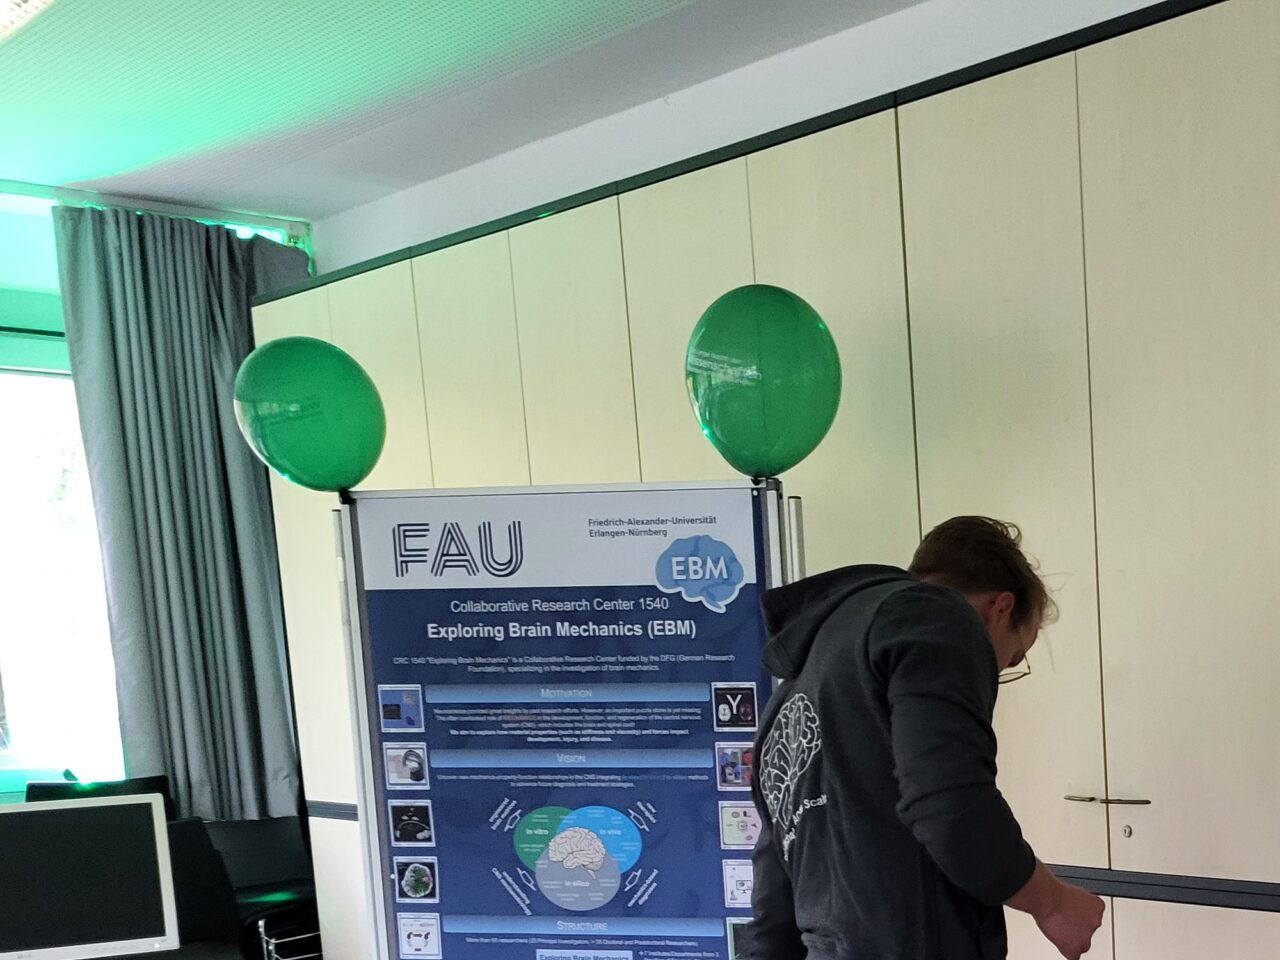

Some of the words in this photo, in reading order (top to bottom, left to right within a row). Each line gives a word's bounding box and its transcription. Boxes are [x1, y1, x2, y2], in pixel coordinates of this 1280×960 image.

[588, 516, 717, 527] Friedrich-Alexander-Universität
[589, 528, 668, 538] Erlangen-Nürnberg
[392, 520, 523, 577] FAU
[671, 556, 729, 580] EBM
[450, 600, 529, 613] Collaborative
[532, 598, 590, 612] Research
[593, 598, 635, 611] Center
[639, 597, 669, 610] 1540
[427, 623, 504, 641] Exploring
[508, 622, 551, 638] Brain
[556, 621, 643, 638] Mechanics
[647, 620, 697, 639] (EBM)
